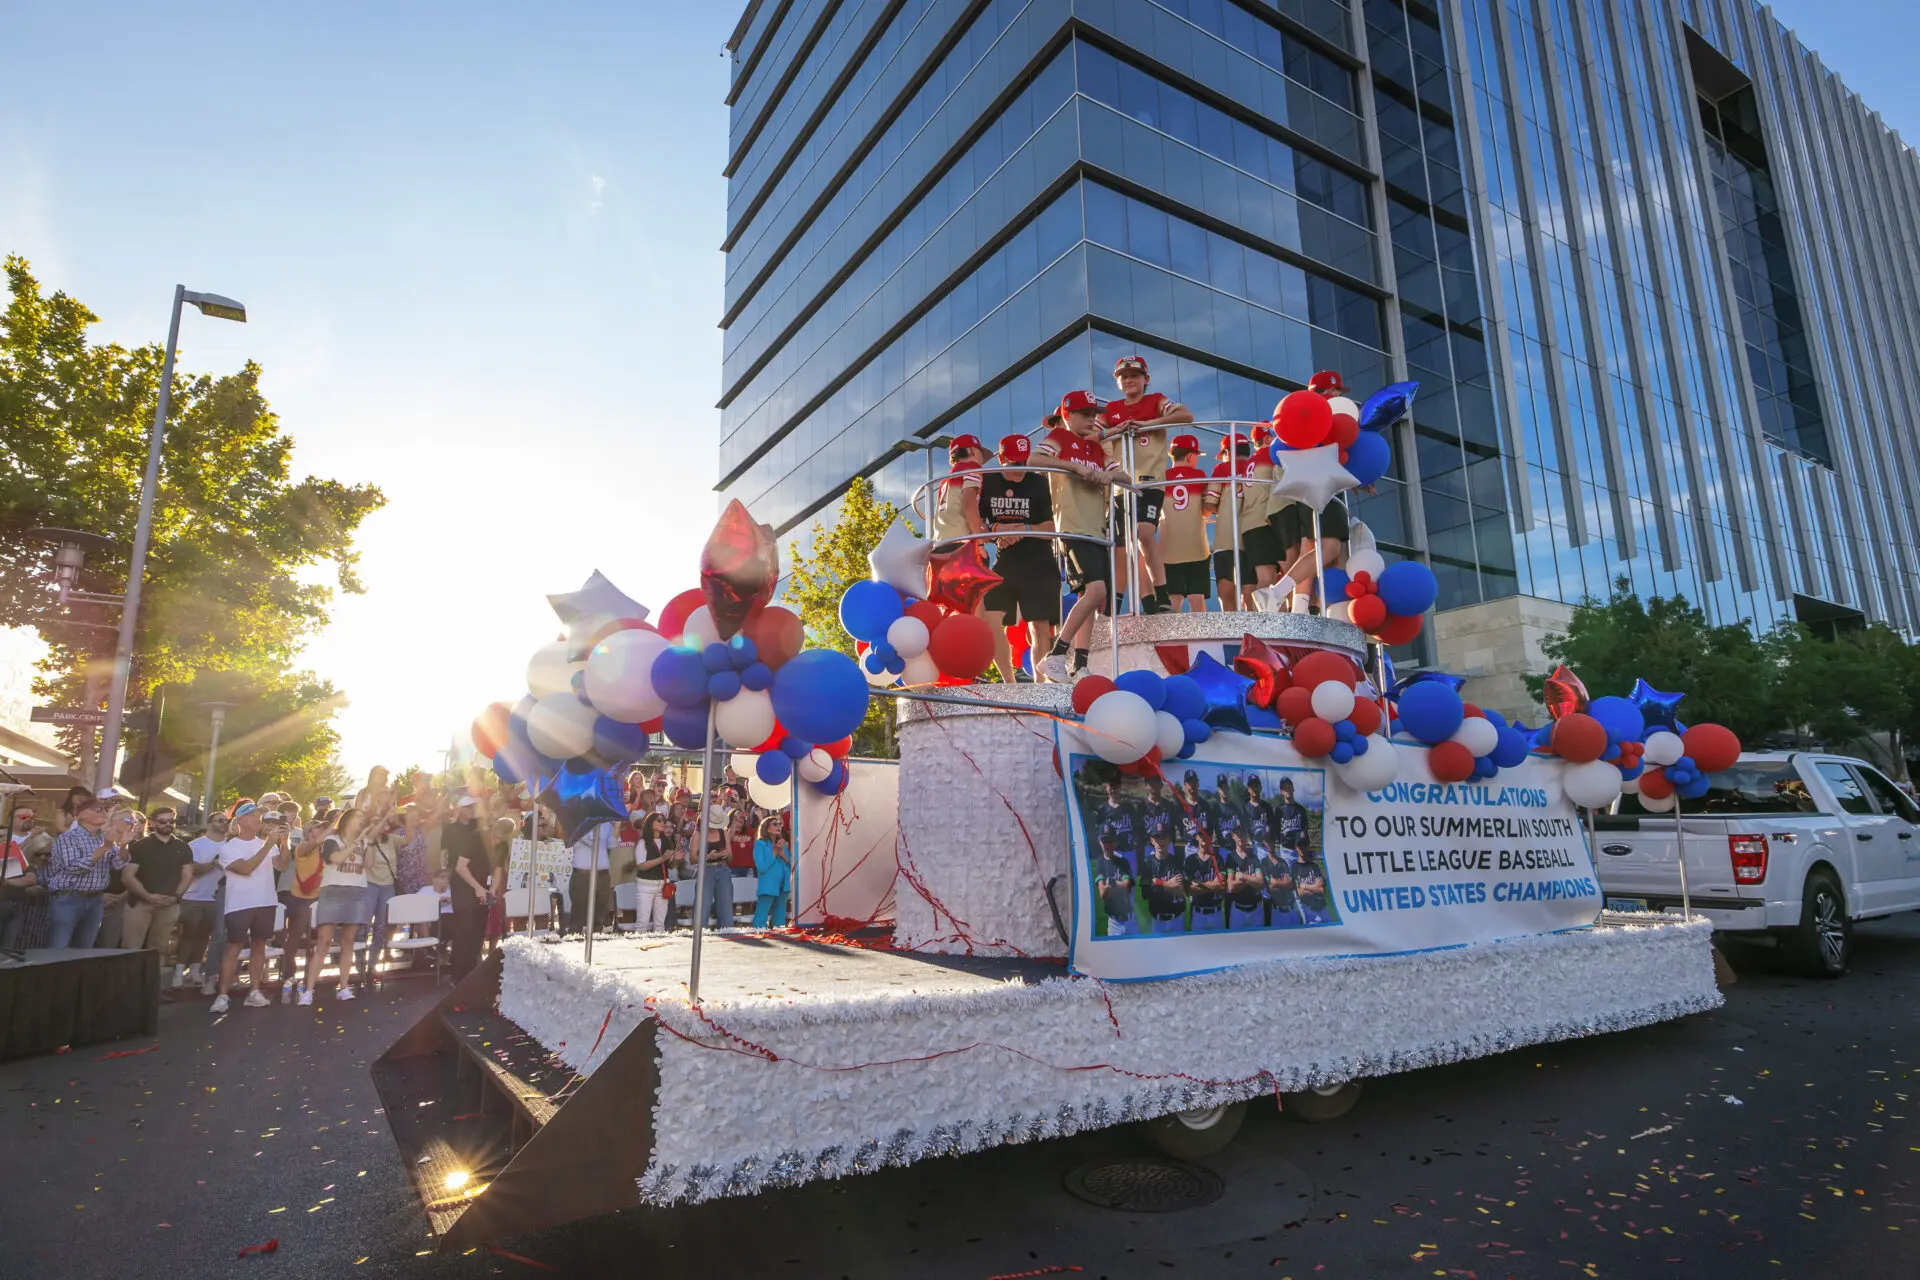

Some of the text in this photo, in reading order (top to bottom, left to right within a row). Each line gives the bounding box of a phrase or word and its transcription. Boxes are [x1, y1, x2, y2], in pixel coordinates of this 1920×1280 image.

[990, 496, 1030, 509] SOUTH
[1172, 484, 1189, 510] 9
[991, 508, 1030, 519] ALL-STARS
[53, 711, 76, 720] PARK
[1335, 815, 1574, 838] TO OUR SUMMERLIN SOUTH
[1343, 848, 1575, 875] LITTLE LEAGUE BASEBALL
[1343, 877, 1596, 913] UNITED STATES CHAMPIONS
